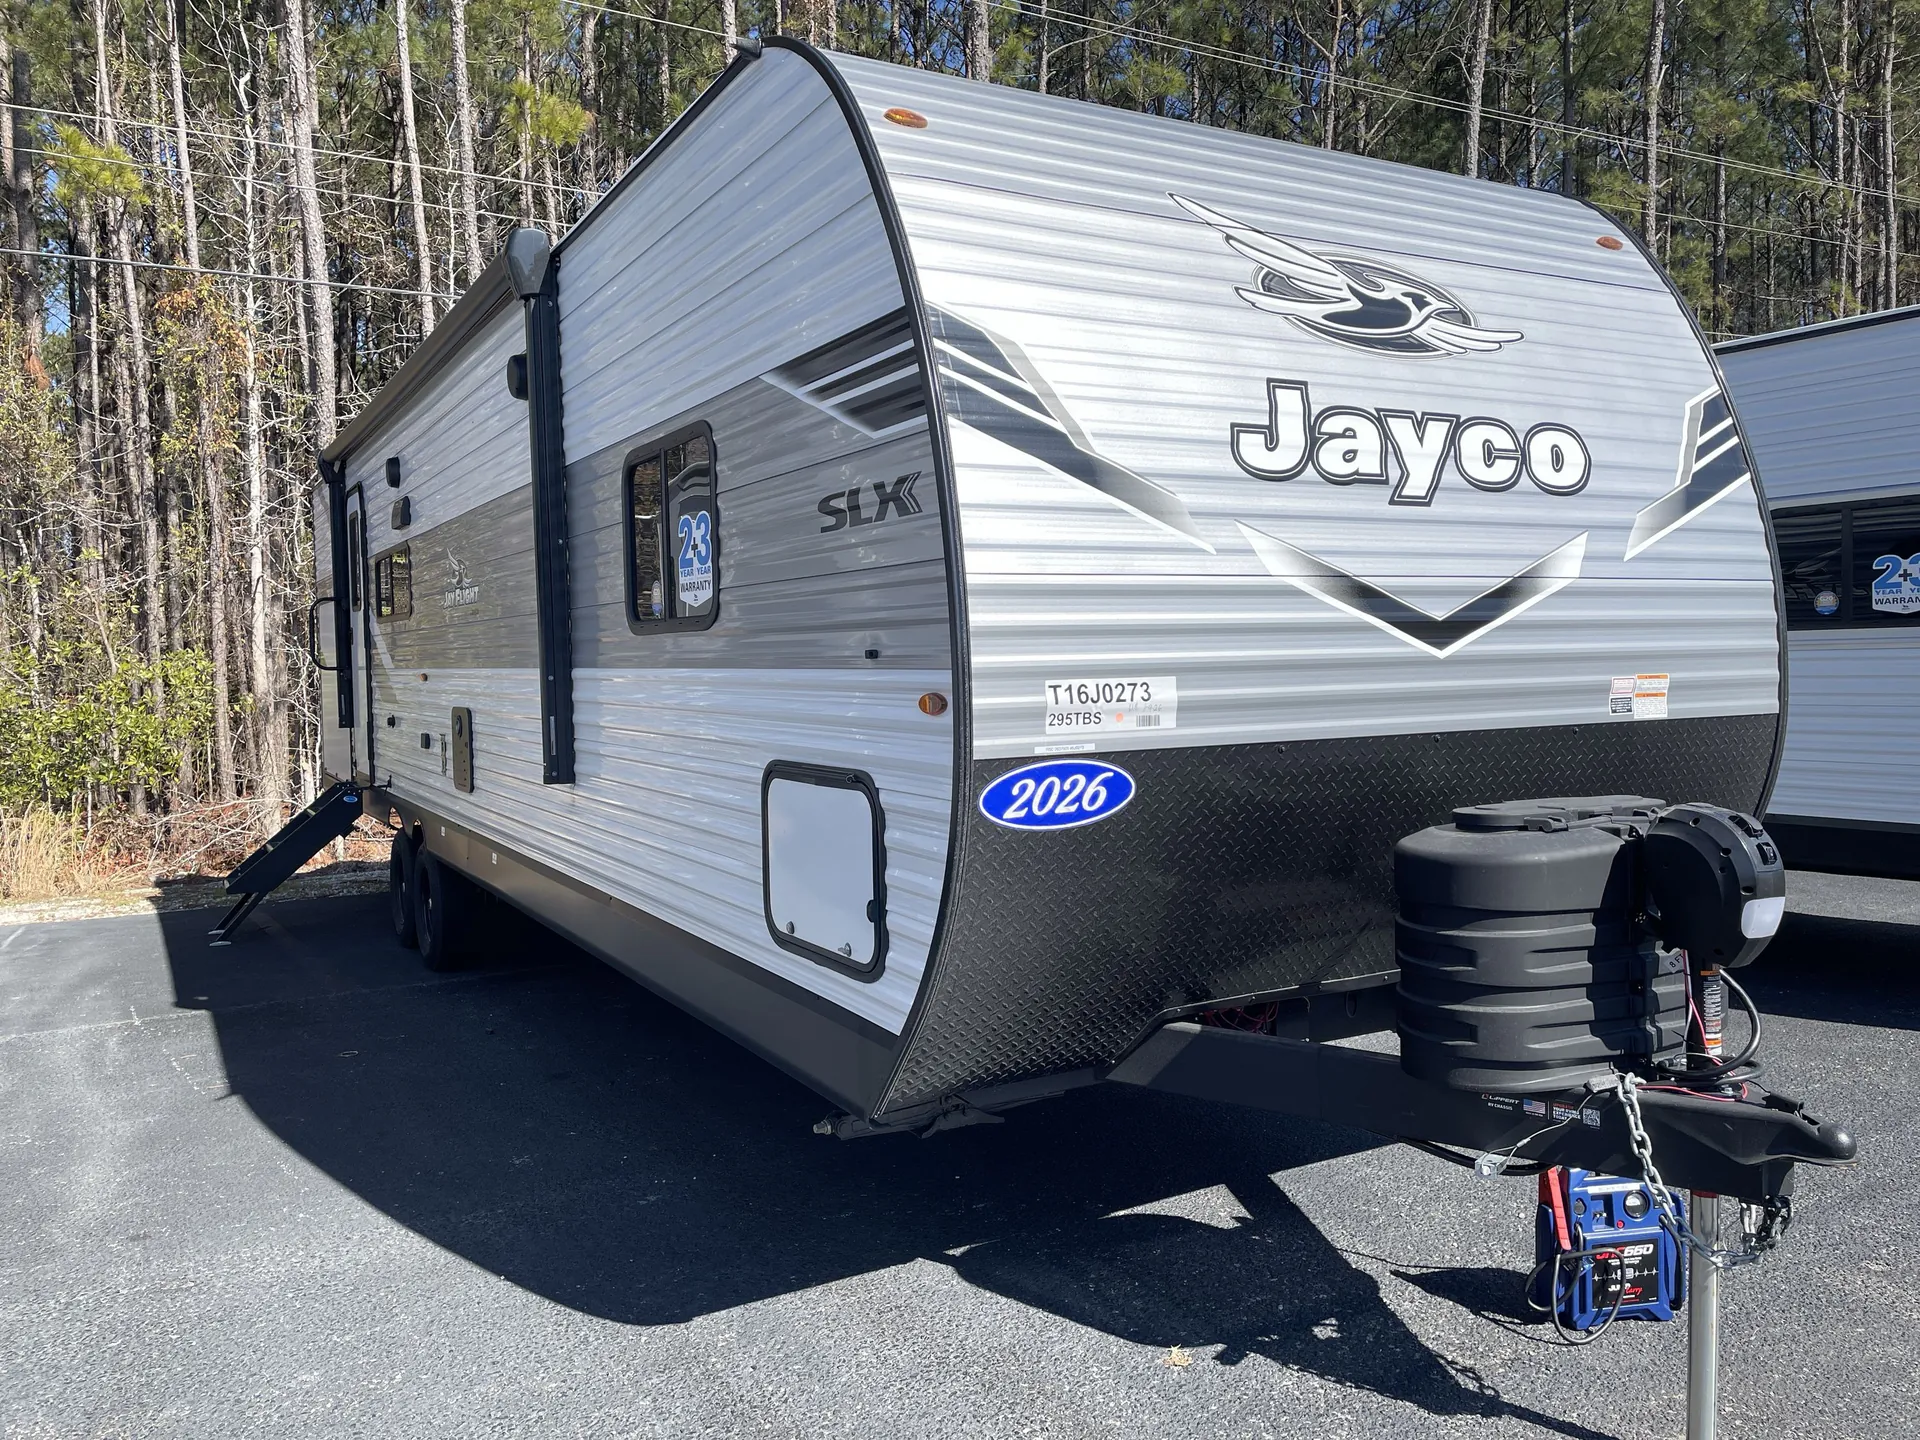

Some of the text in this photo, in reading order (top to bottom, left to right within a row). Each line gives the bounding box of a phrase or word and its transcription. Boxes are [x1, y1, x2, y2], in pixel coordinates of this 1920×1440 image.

[1230, 377, 1592, 507] Jayco
[817, 470, 923, 534] SLX
[680, 565, 712, 578] YEAR YEAR
[680, 579, 712, 593] WARRANTY
[1875, 588, 1903, 596] YEAR
[1048, 682, 1152, 705] T16J0273
[1048, 711, 1102, 727] 295TBS
[1002, 771, 1115, 820] 2026
[1608, 1282, 1632, 1291] JUP
